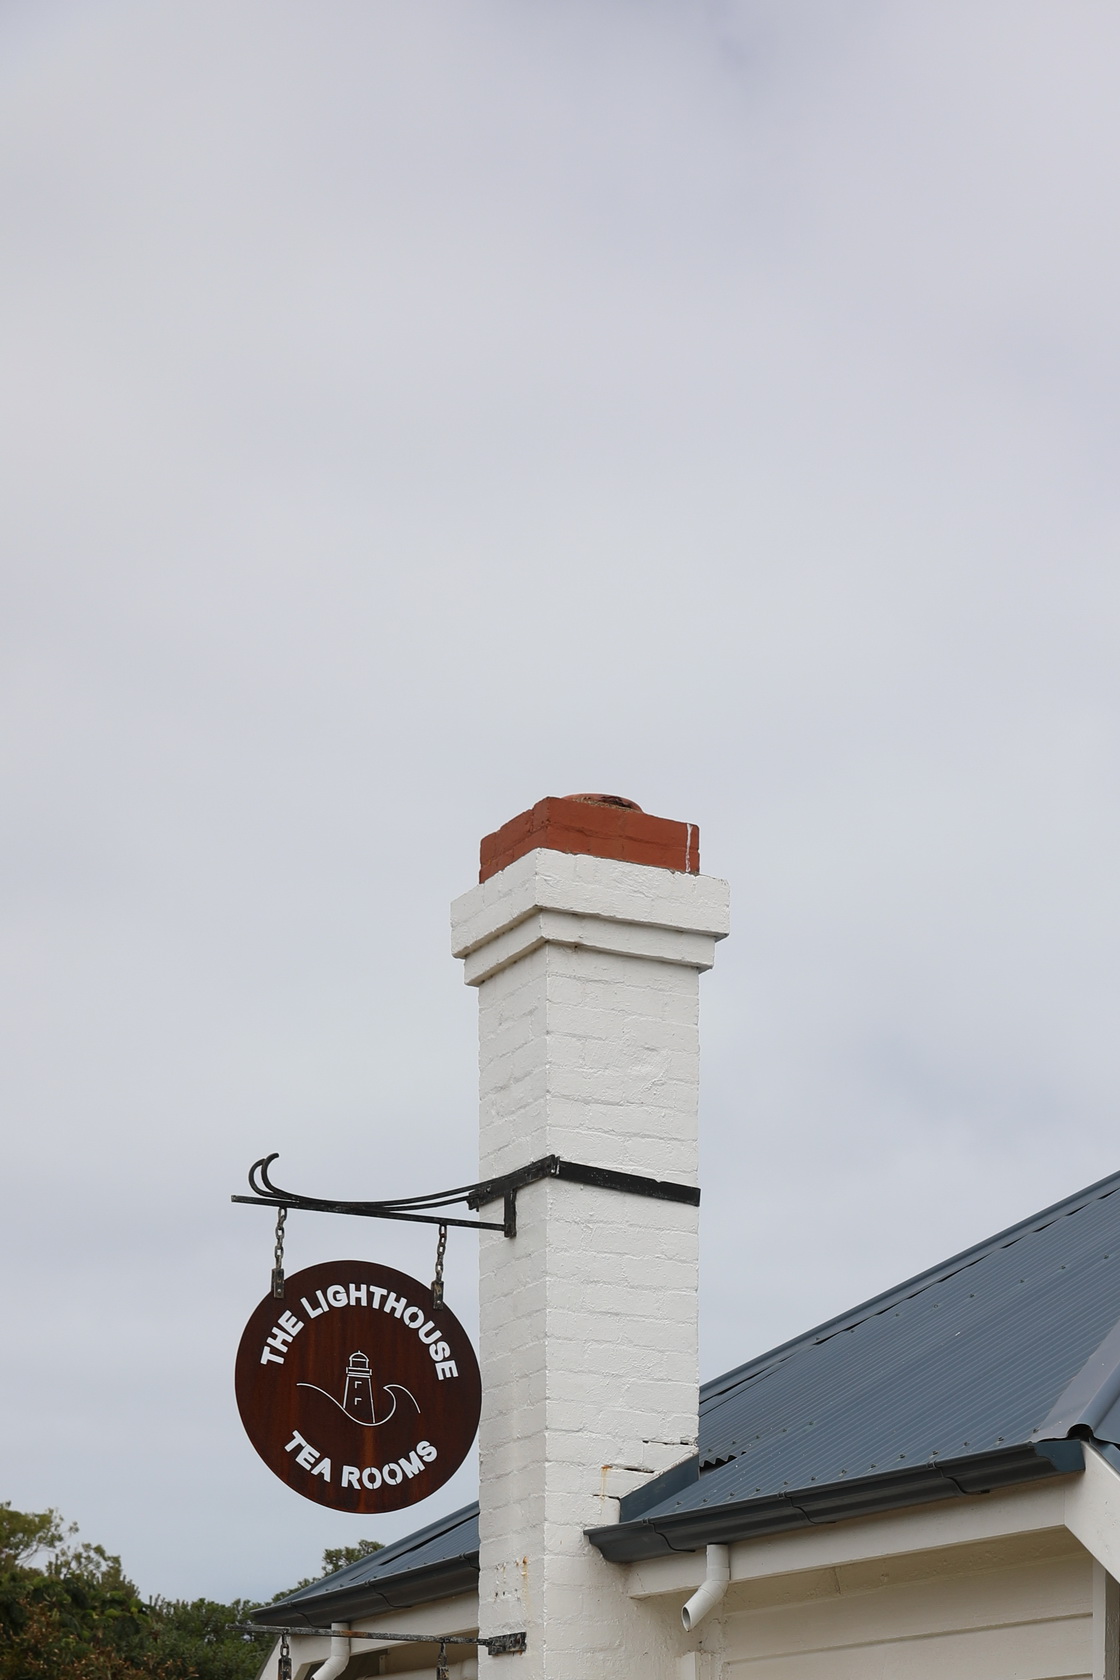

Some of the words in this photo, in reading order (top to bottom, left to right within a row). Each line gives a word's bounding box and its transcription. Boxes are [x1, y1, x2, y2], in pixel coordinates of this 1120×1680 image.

[260, 1309, 305, 1366] THE
[300, 1283, 459, 1381] LIGHTHOUSE
[284, 1429, 332, 1483] TEA
[341, 1440, 438, 1490] ROOMS
